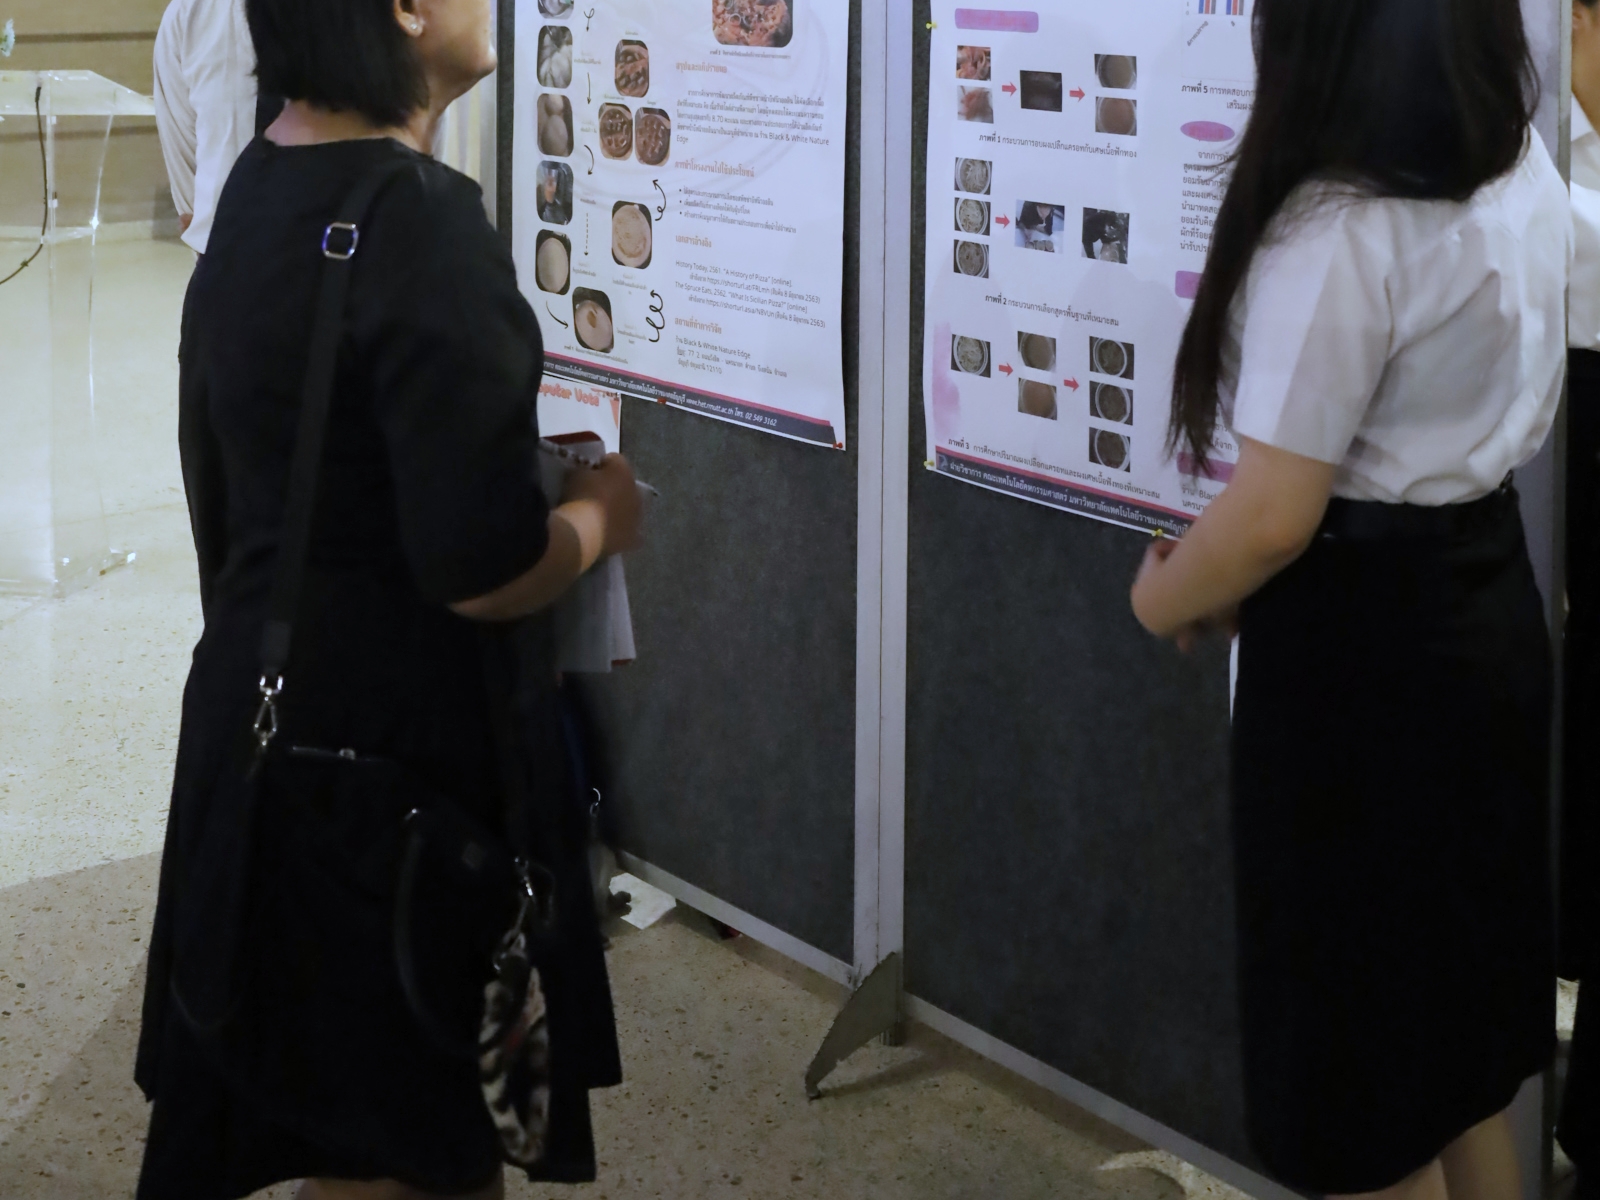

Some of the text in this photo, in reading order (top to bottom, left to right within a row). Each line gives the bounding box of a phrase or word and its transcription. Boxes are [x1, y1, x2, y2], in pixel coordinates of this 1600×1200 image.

[1181, 78, 1208, 94] ภาพที่ 5
[676, 135, 688, 144] Edge
[768, 132, 783, 141] Black
[791, 134, 807, 143] White
[809, 136, 829, 146] Nature
[676, 260, 692, 270] History
[730, 269, 747, 280] History
[684, 282, 700, 292] Spruce
[805, 293, 820, 304] 2563)
[810, 317, 825, 328] 2563)
[683, 336, 696, 346] Black
[703, 341, 717, 351] White
[718, 344, 736, 355] Nature
[737, 349, 750, 360] Edge
[744, 411, 751, 420] 02
[753, 413, 762, 423] 549
